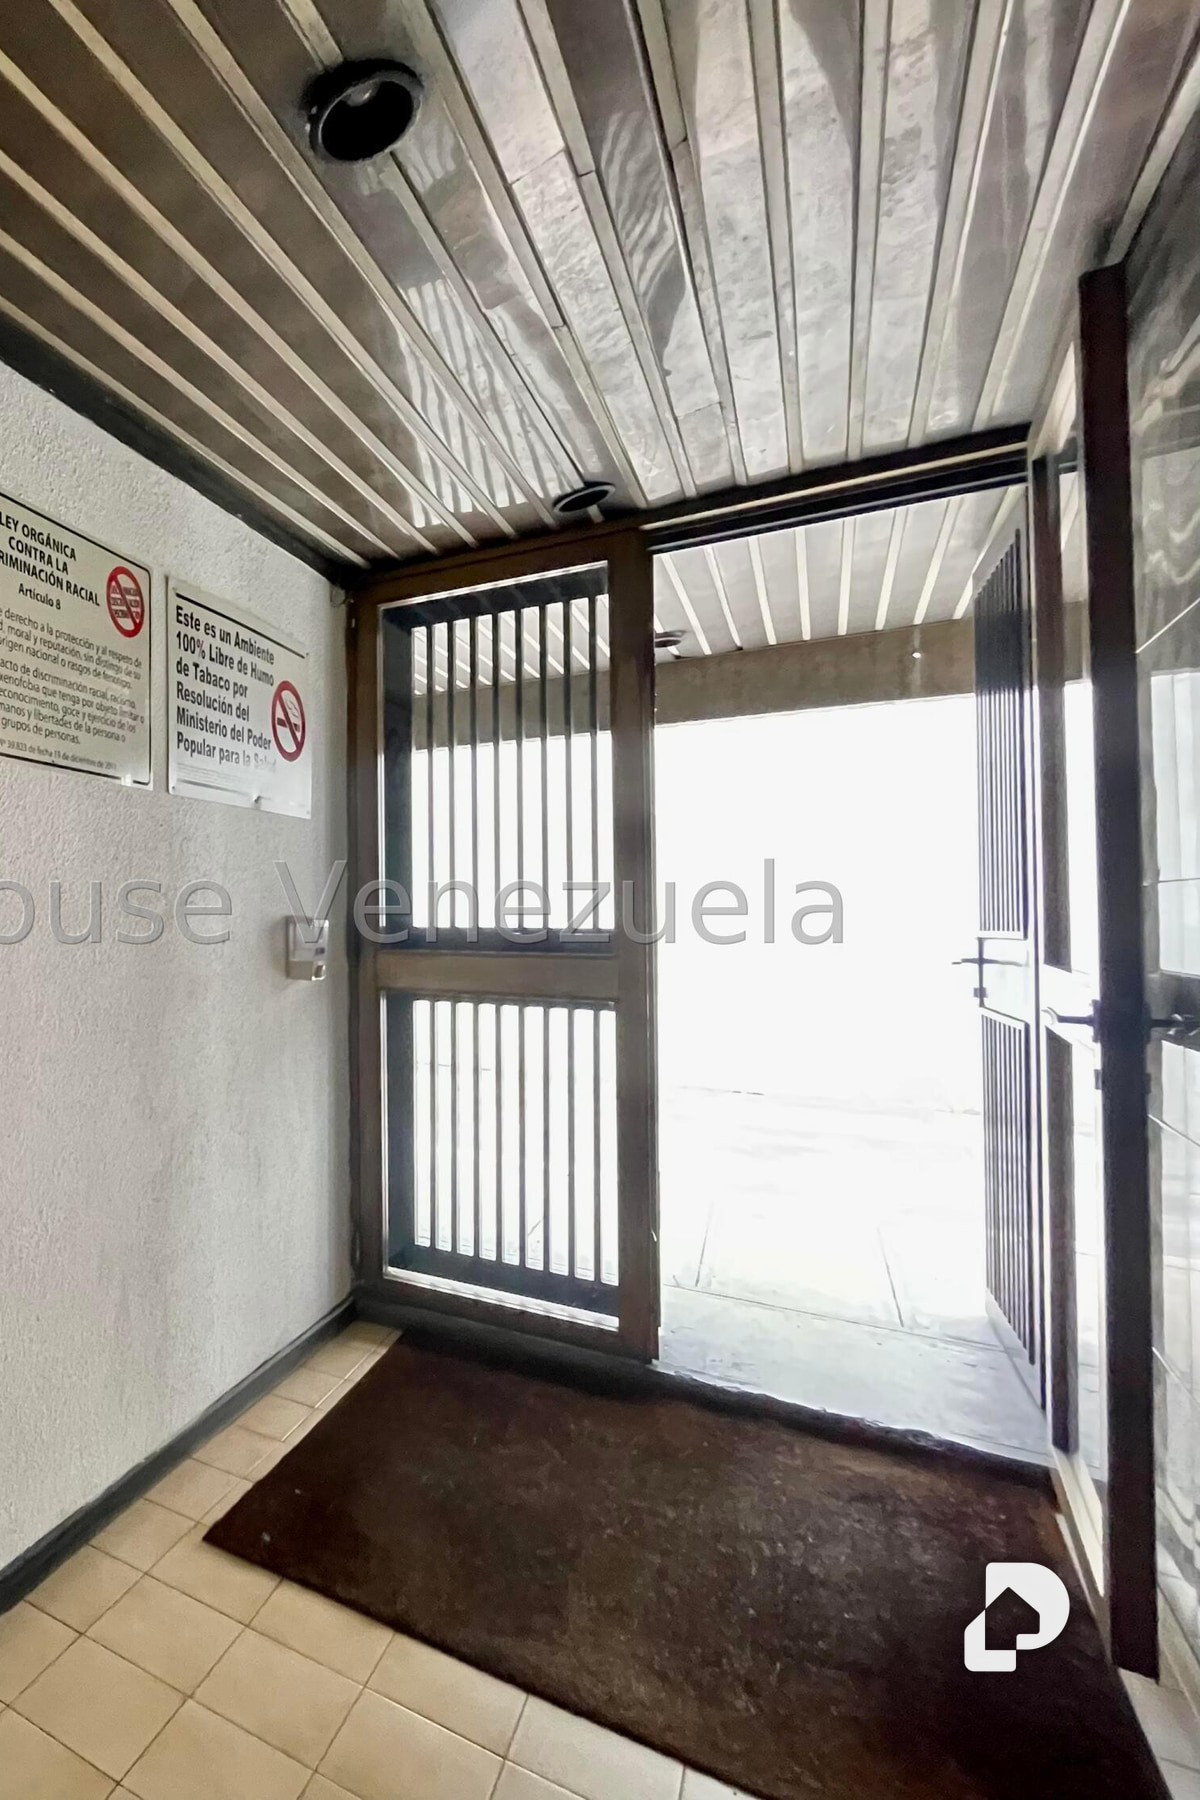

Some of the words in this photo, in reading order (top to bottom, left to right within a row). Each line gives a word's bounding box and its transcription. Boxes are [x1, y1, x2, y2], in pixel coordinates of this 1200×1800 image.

[0, 511, 18, 532] LEY
[21, 523, 76, 561] ORGÁNICA
[8, 536, 53, 568] CONTRA
[55, 557, 68, 575] LA
[18, 582, 54, 607] Artículo
[55, 598, 61, 610] 8
[65, 579, 99, 606] RACIAL
[4, 607, 38, 630] derecho
[39, 623, 45, 632] a
[46, 622, 53, 635] la
[55, 629, 94, 650] protección
[176, 605, 200, 631] Este
[204, 622, 216, 638] es
[220, 628, 231, 645] un
[234, 631, 274, 665] Ambiente
[7, 625, 31, 641] moral
[39, 637, 82, 660] reputación,
[83, 651, 94, 663] sin
[133, 670, 141, 680] su
[25, 644, 59, 664] nacional
[67, 660, 91, 675] rasgos
[177, 631, 205, 660] 100%
[209, 643, 234, 670] Libre
[237, 657, 248, 675] de
[251, 661, 274, 687] Humo
[0, 658, 18, 672] acto
[19, 663, 30, 676] de
[32, 666, 87, 693] discriminación
[88, 687, 109, 701] racial,
[41, 685, 56, 698] que
[58, 689, 80, 706] tenga
[81, 697, 94, 708] por
[176, 657, 189, 677] de
[193, 663, 230, 692] Tabaco
[233, 681, 248, 698] por
[61, 705, 80, 718] goce
[177, 681, 233, 716] Resolución
[235, 703, 249, 722] del
[0, 716, 31, 732] grupos
[32, 722, 43, 735] de
[44, 727, 80, 744] personas.
[73, 719, 83, 732] de
[84, 721, 91, 734] la
[91, 722, 120, 741] persona
[177, 706, 228, 737] Ministerio
[230, 724, 244, 743] del
[247, 728, 271, 750] Poder
[177, 731, 216, 758] Popular
[219, 746, 240, 764] para
[243, 750, 250, 767] la
[254, 753, 277, 772] Sald
